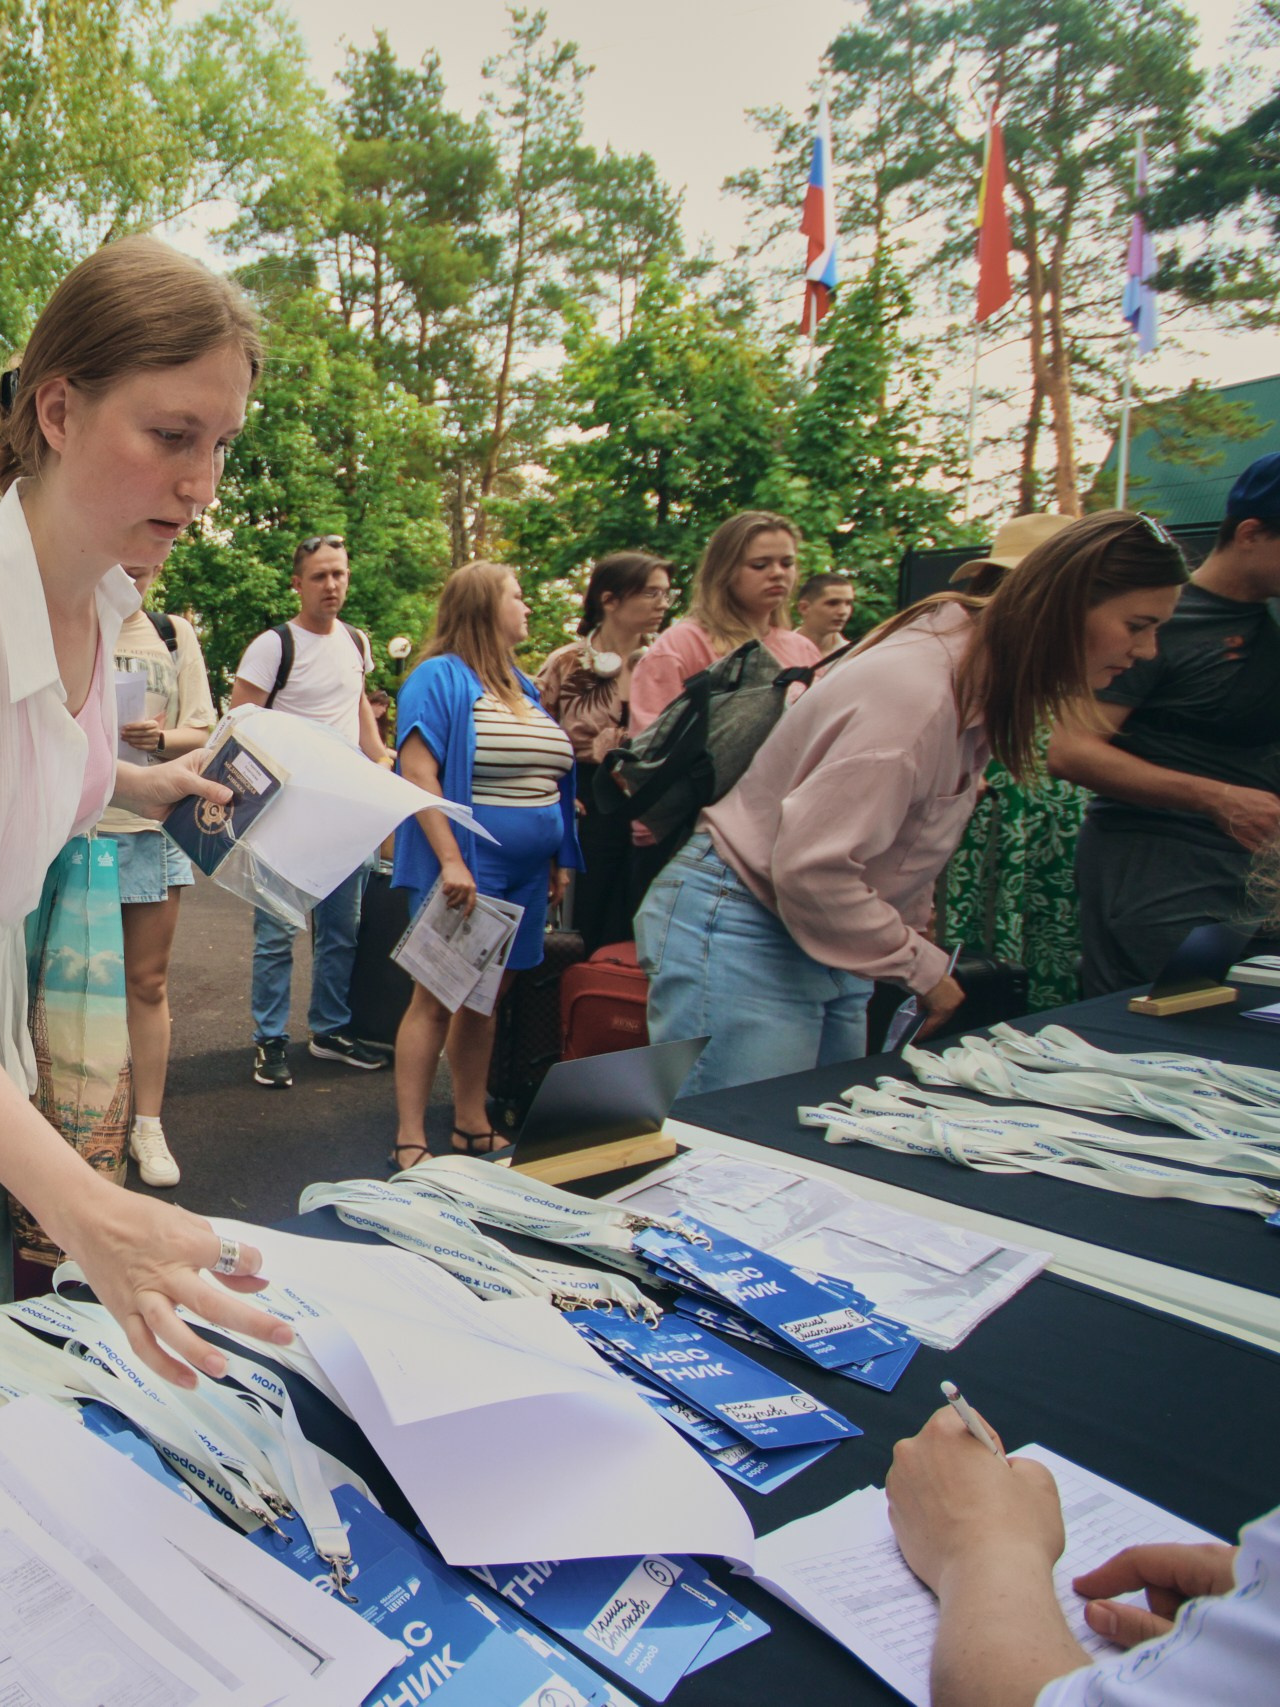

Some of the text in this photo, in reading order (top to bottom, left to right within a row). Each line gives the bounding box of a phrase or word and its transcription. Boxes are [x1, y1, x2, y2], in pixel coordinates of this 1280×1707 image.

[251, 1372, 277, 1394] мол
[500, 1559, 561, 1608] тни
[386, 1592, 411, 1613] ЦЕНТР
